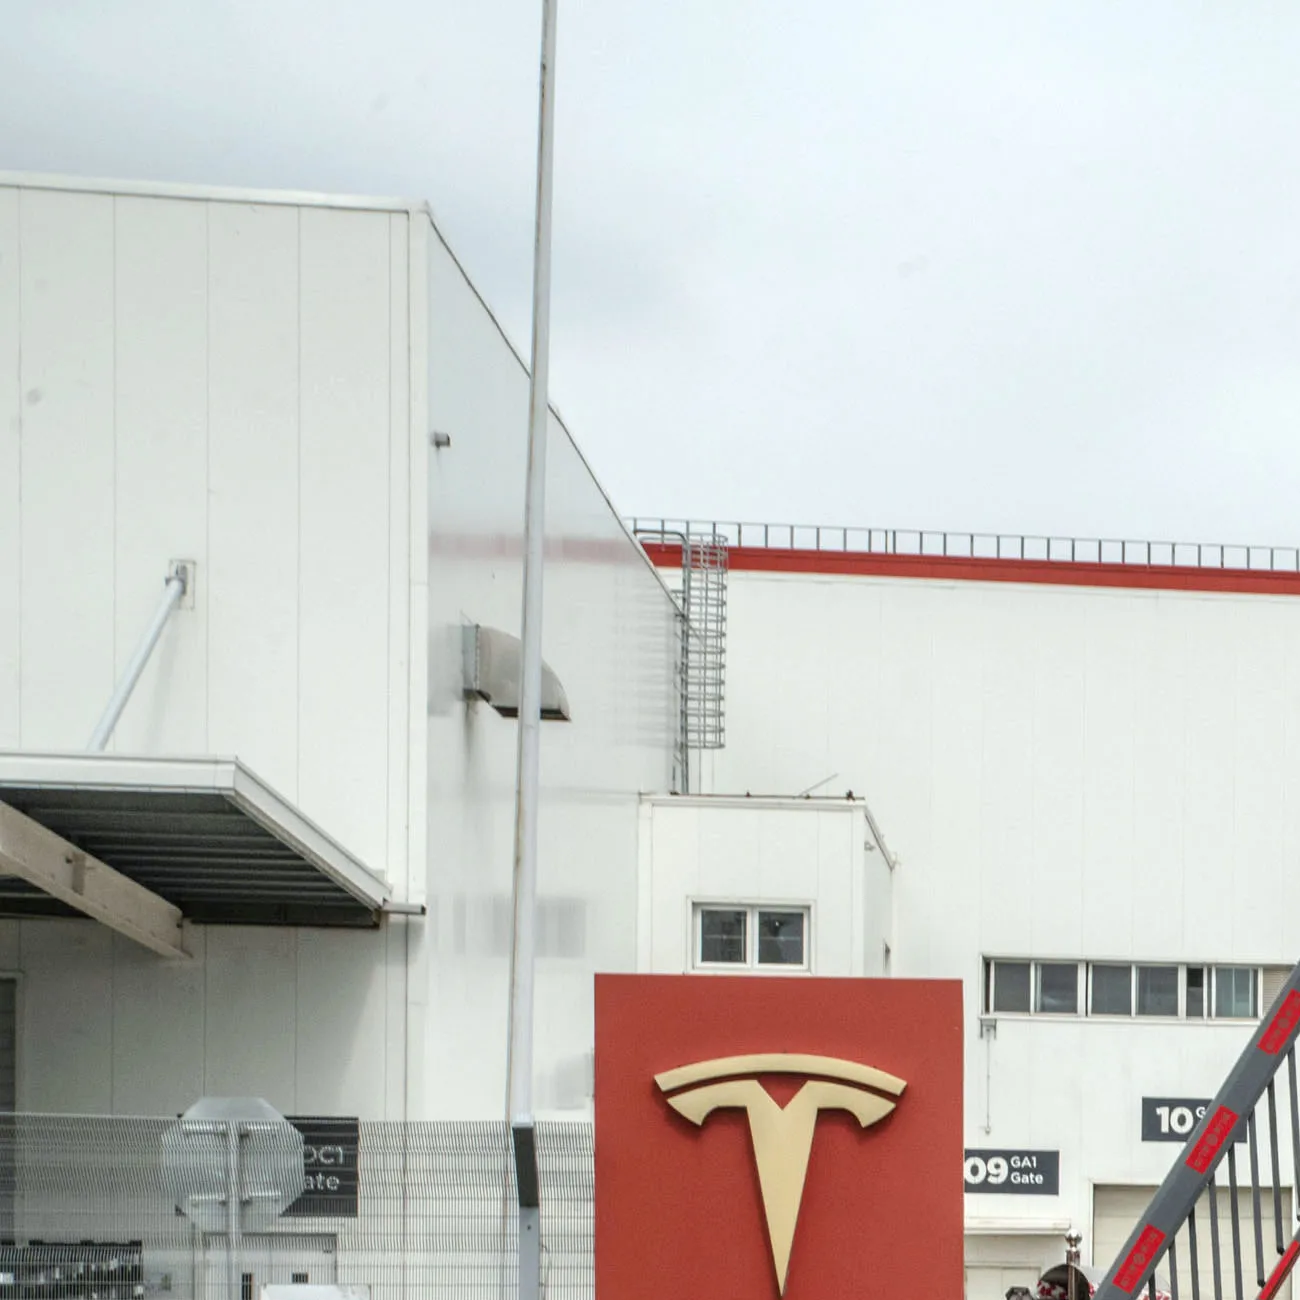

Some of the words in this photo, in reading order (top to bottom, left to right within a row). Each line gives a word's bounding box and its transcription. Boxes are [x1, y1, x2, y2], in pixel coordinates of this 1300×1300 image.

[1156, 1106, 1194, 1134] 10
[303, 1173, 340, 1191] ate
[964, 1157, 1009, 1185] 09
[1010, 1156, 1037, 1168] GA1
[1010, 1172, 1044, 1185] Gate
